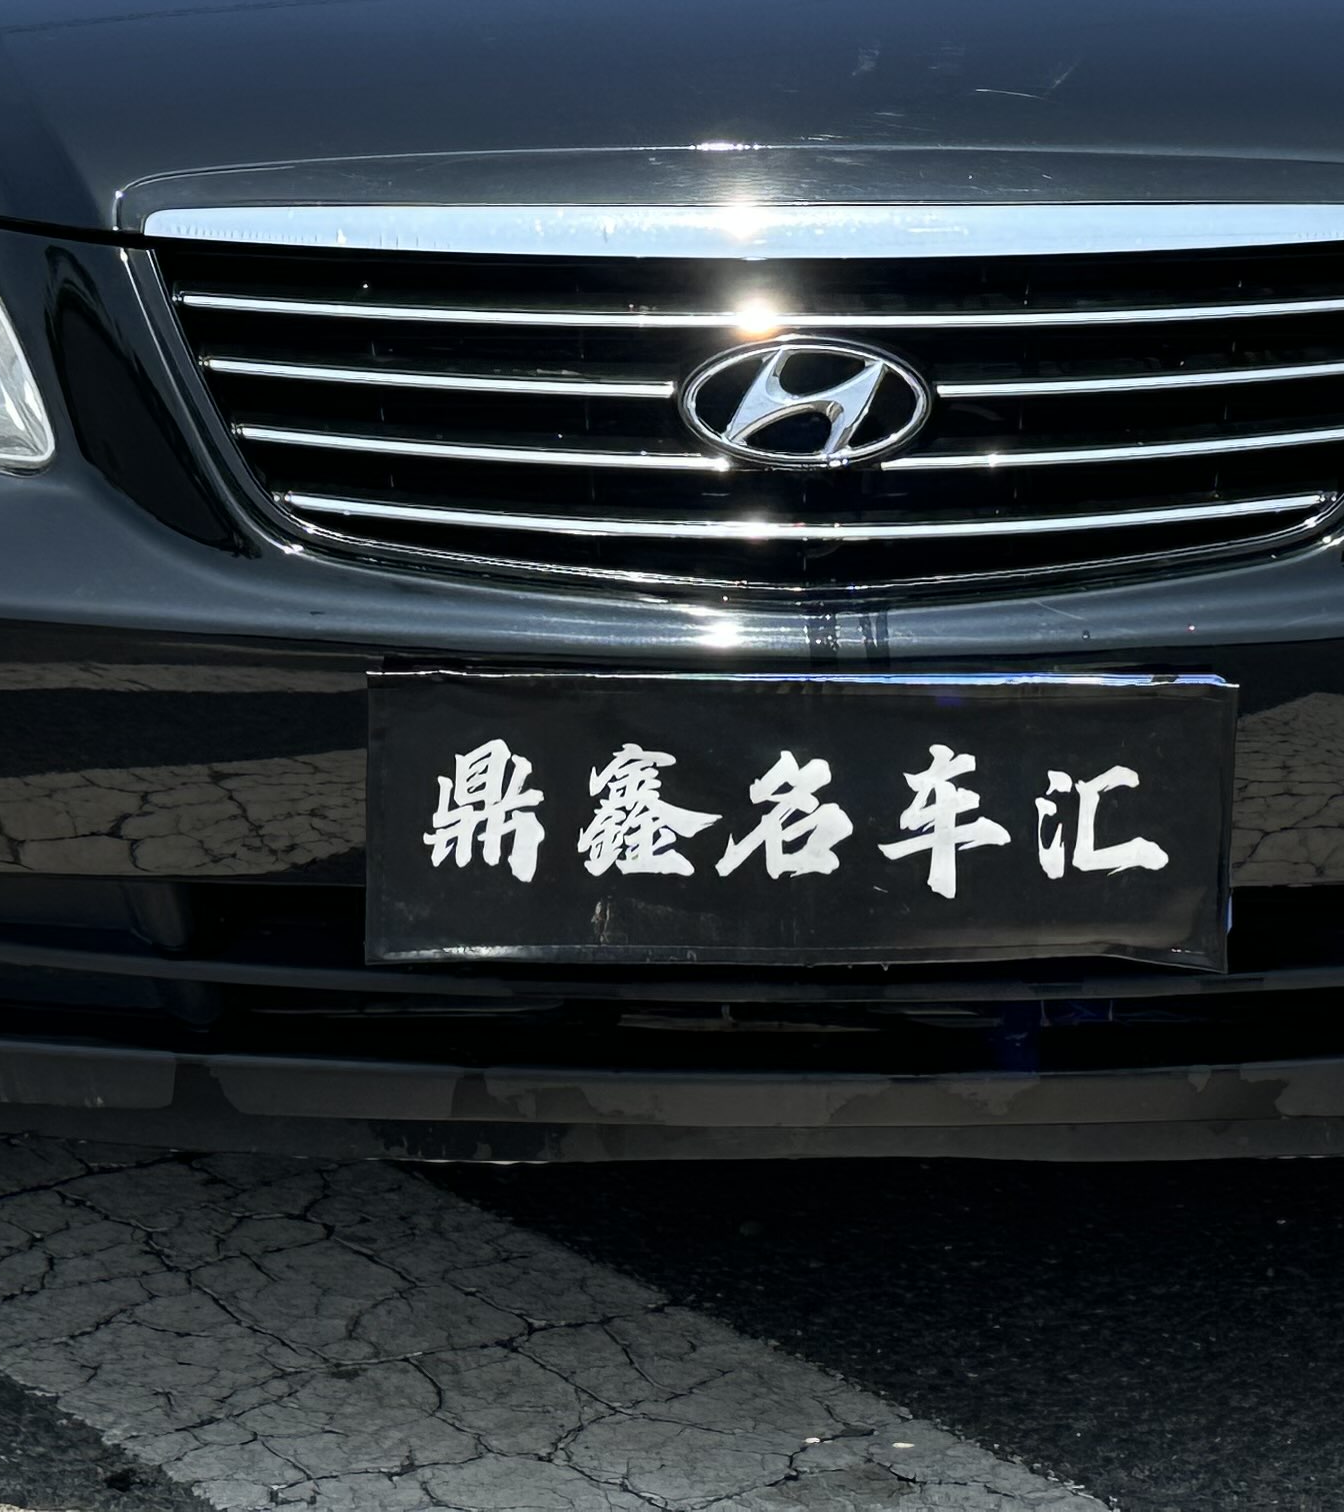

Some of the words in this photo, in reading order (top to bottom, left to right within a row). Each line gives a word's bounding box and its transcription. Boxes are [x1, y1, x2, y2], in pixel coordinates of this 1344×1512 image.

[422, 738, 1169, 899] 鼎鑫名车汇
